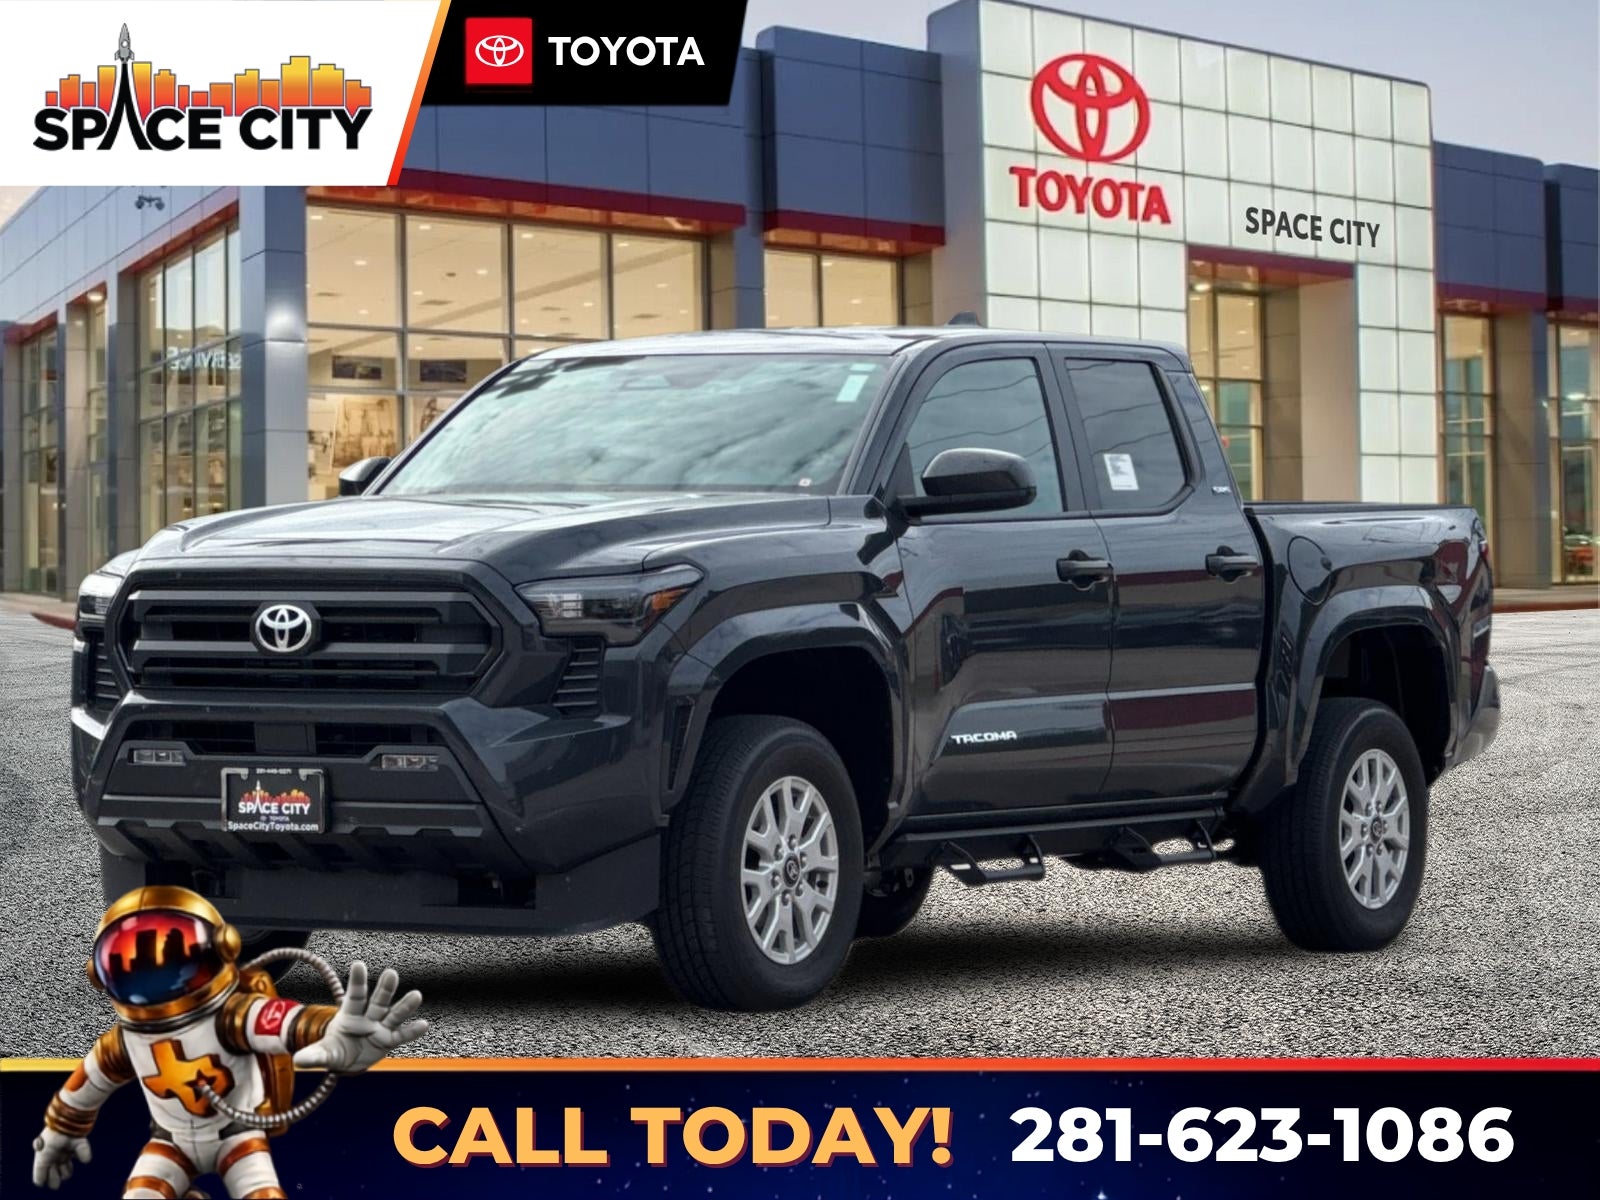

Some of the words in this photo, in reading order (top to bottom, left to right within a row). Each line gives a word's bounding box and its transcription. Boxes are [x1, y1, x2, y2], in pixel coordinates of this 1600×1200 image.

[1009, 165, 1171, 224] TOYOTA
[1245, 206, 1323, 242] SPACE
[1329, 217, 1381, 248] CITY
[950, 730, 1018, 745] TACOMA
[238, 801, 279, 815] SPACE
[281, 803, 311, 815] CITY
[227, 821, 319, 832] SpaceCityToyota.com
